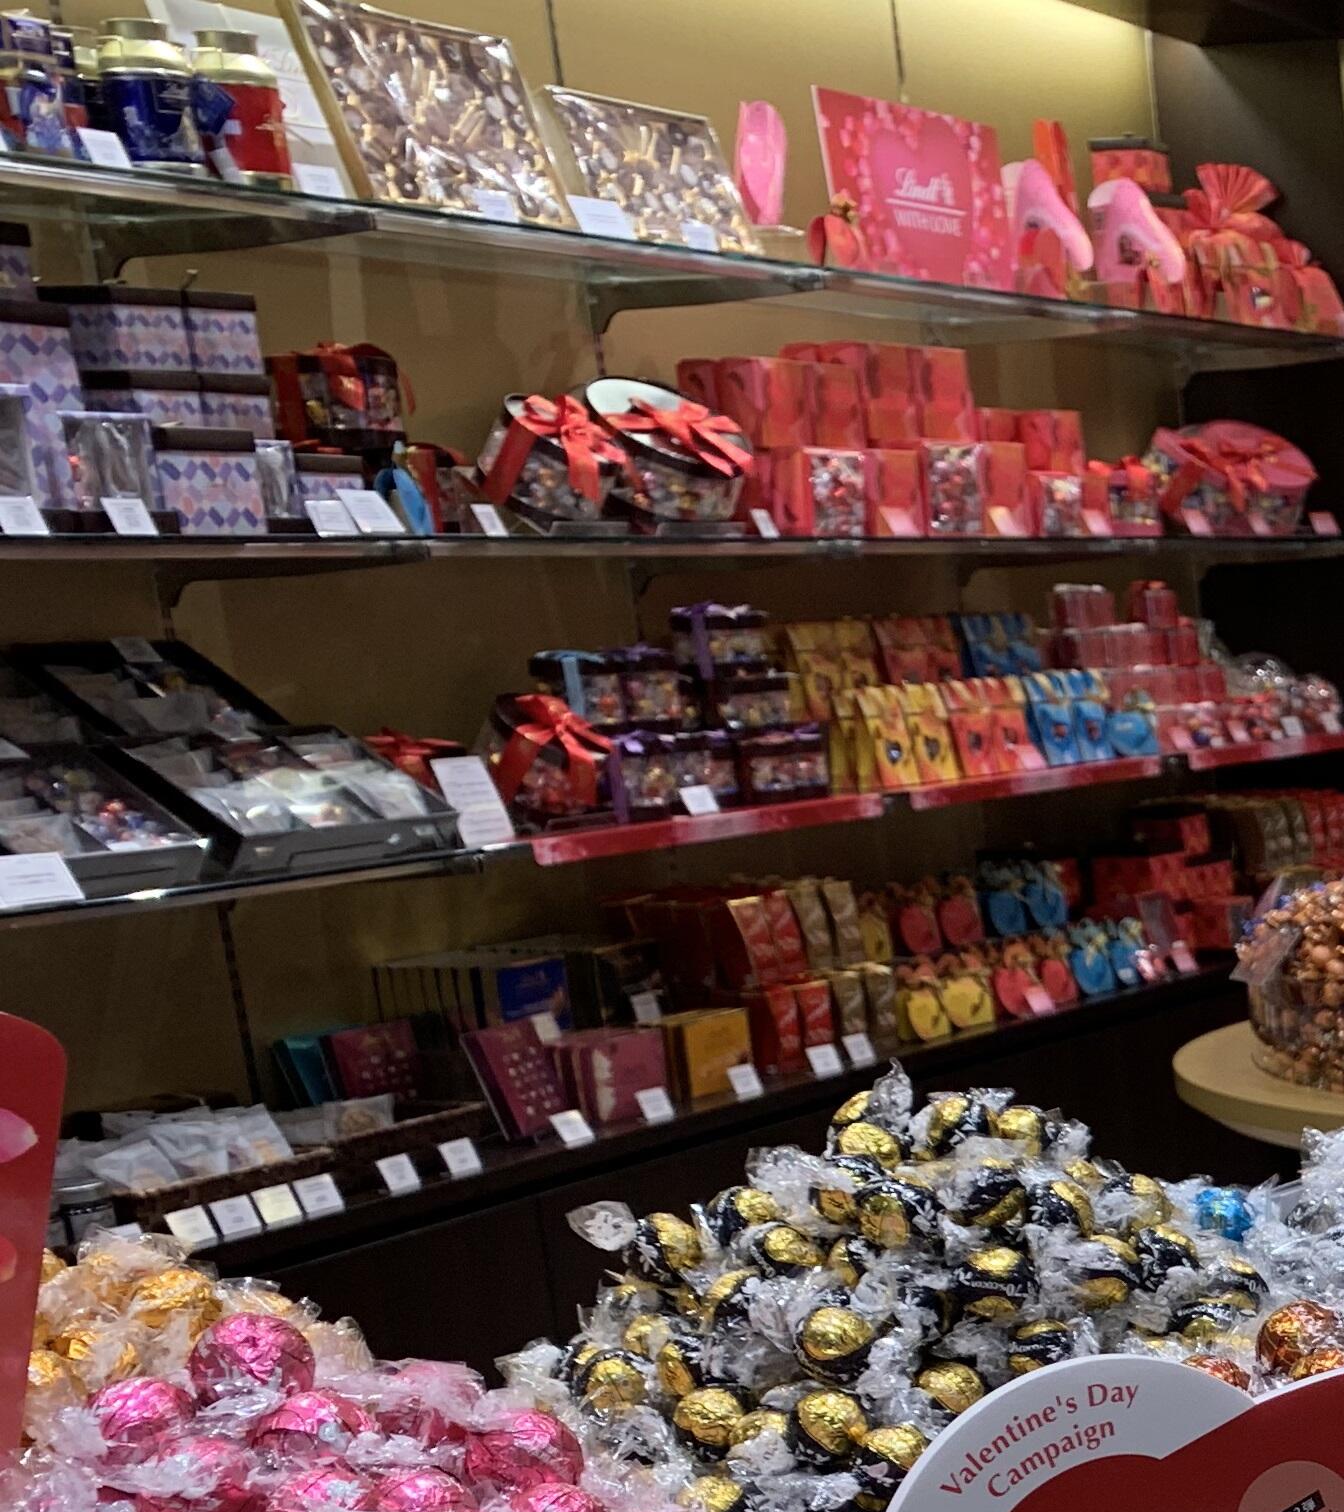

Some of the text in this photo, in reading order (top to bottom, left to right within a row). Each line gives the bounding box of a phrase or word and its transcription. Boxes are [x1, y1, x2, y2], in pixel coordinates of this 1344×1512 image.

[940, 1383, 1140, 1496] Valentine's Day
[986, 1420, 1116, 1498] Campaign
